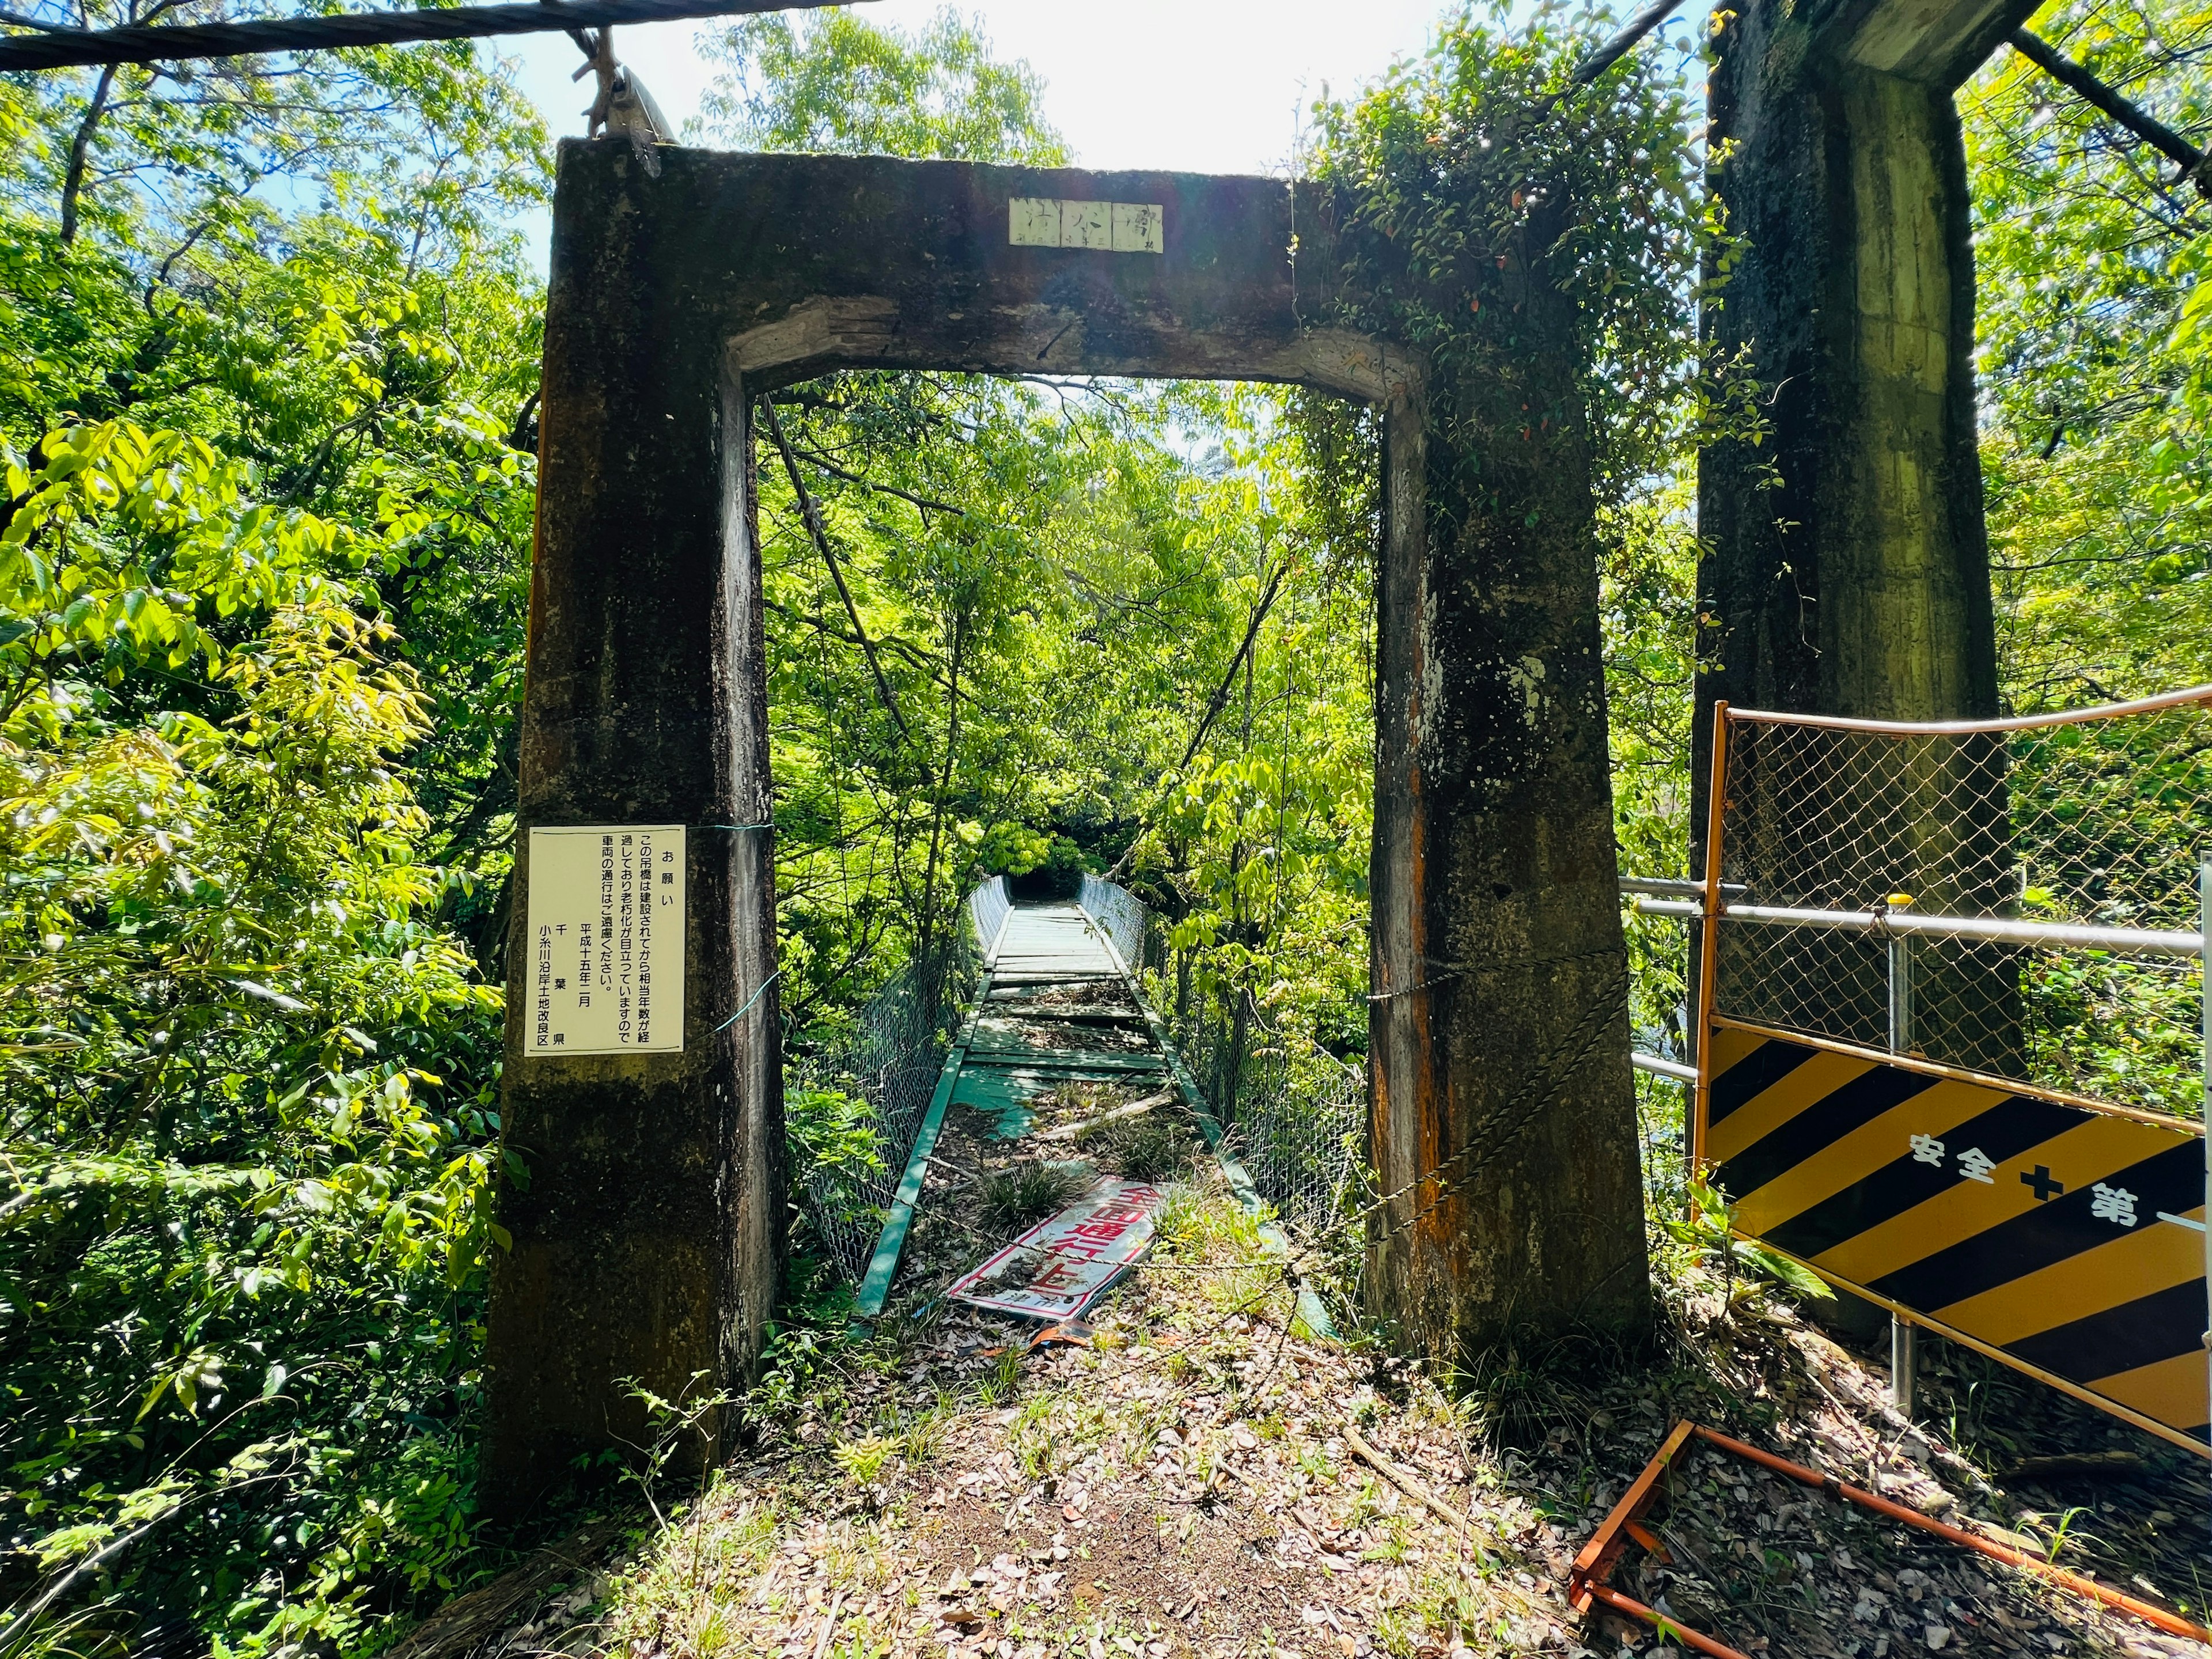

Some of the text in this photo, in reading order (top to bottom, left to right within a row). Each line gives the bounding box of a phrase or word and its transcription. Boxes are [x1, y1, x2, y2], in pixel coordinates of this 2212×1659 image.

[600, 835, 613, 991] 車両の通行はご遠慮ください。
[618, 835, 632, 1043] 過しており老朽化が目立っていますので
[638, 835, 652, 1043] この吊橋は建設されてから相当年数が経
[661, 850, 674, 906] お願い
[537, 925, 551, 1046] 小糸川沿岸土地改良区
[578, 923, 592, 1007] 平成十五年二月
